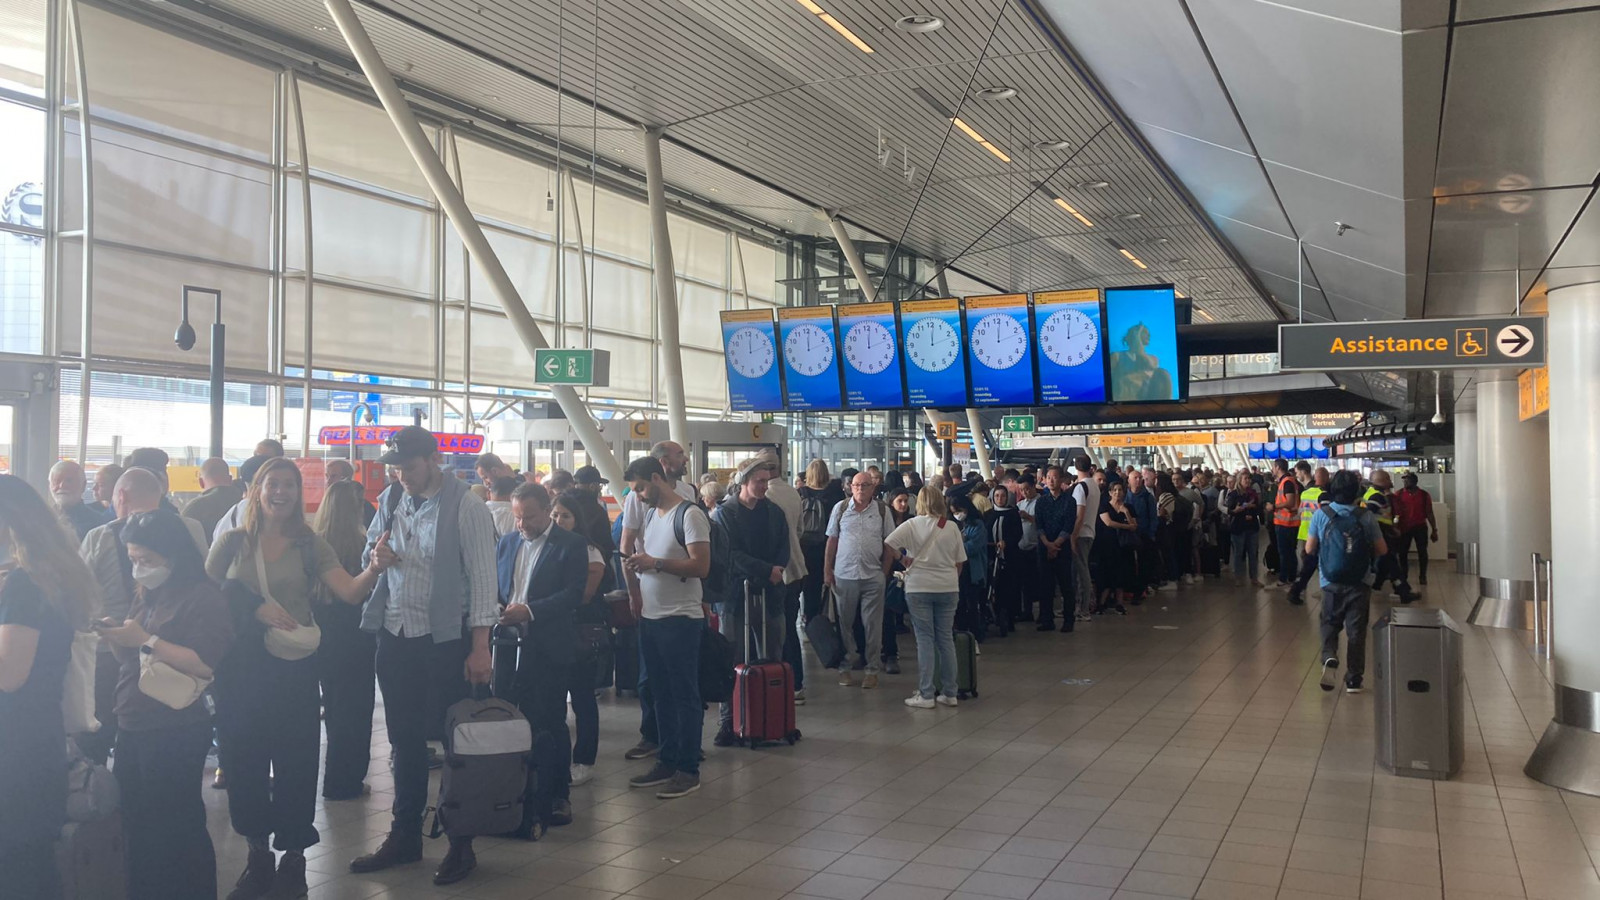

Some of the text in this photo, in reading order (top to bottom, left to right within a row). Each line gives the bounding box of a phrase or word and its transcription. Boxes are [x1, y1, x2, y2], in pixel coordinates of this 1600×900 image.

[1330, 336, 1448, 353] Assistance
[634, 422, 645, 435] C
[753, 425, 759, 438] C
[461, 438, 481, 448] GO
